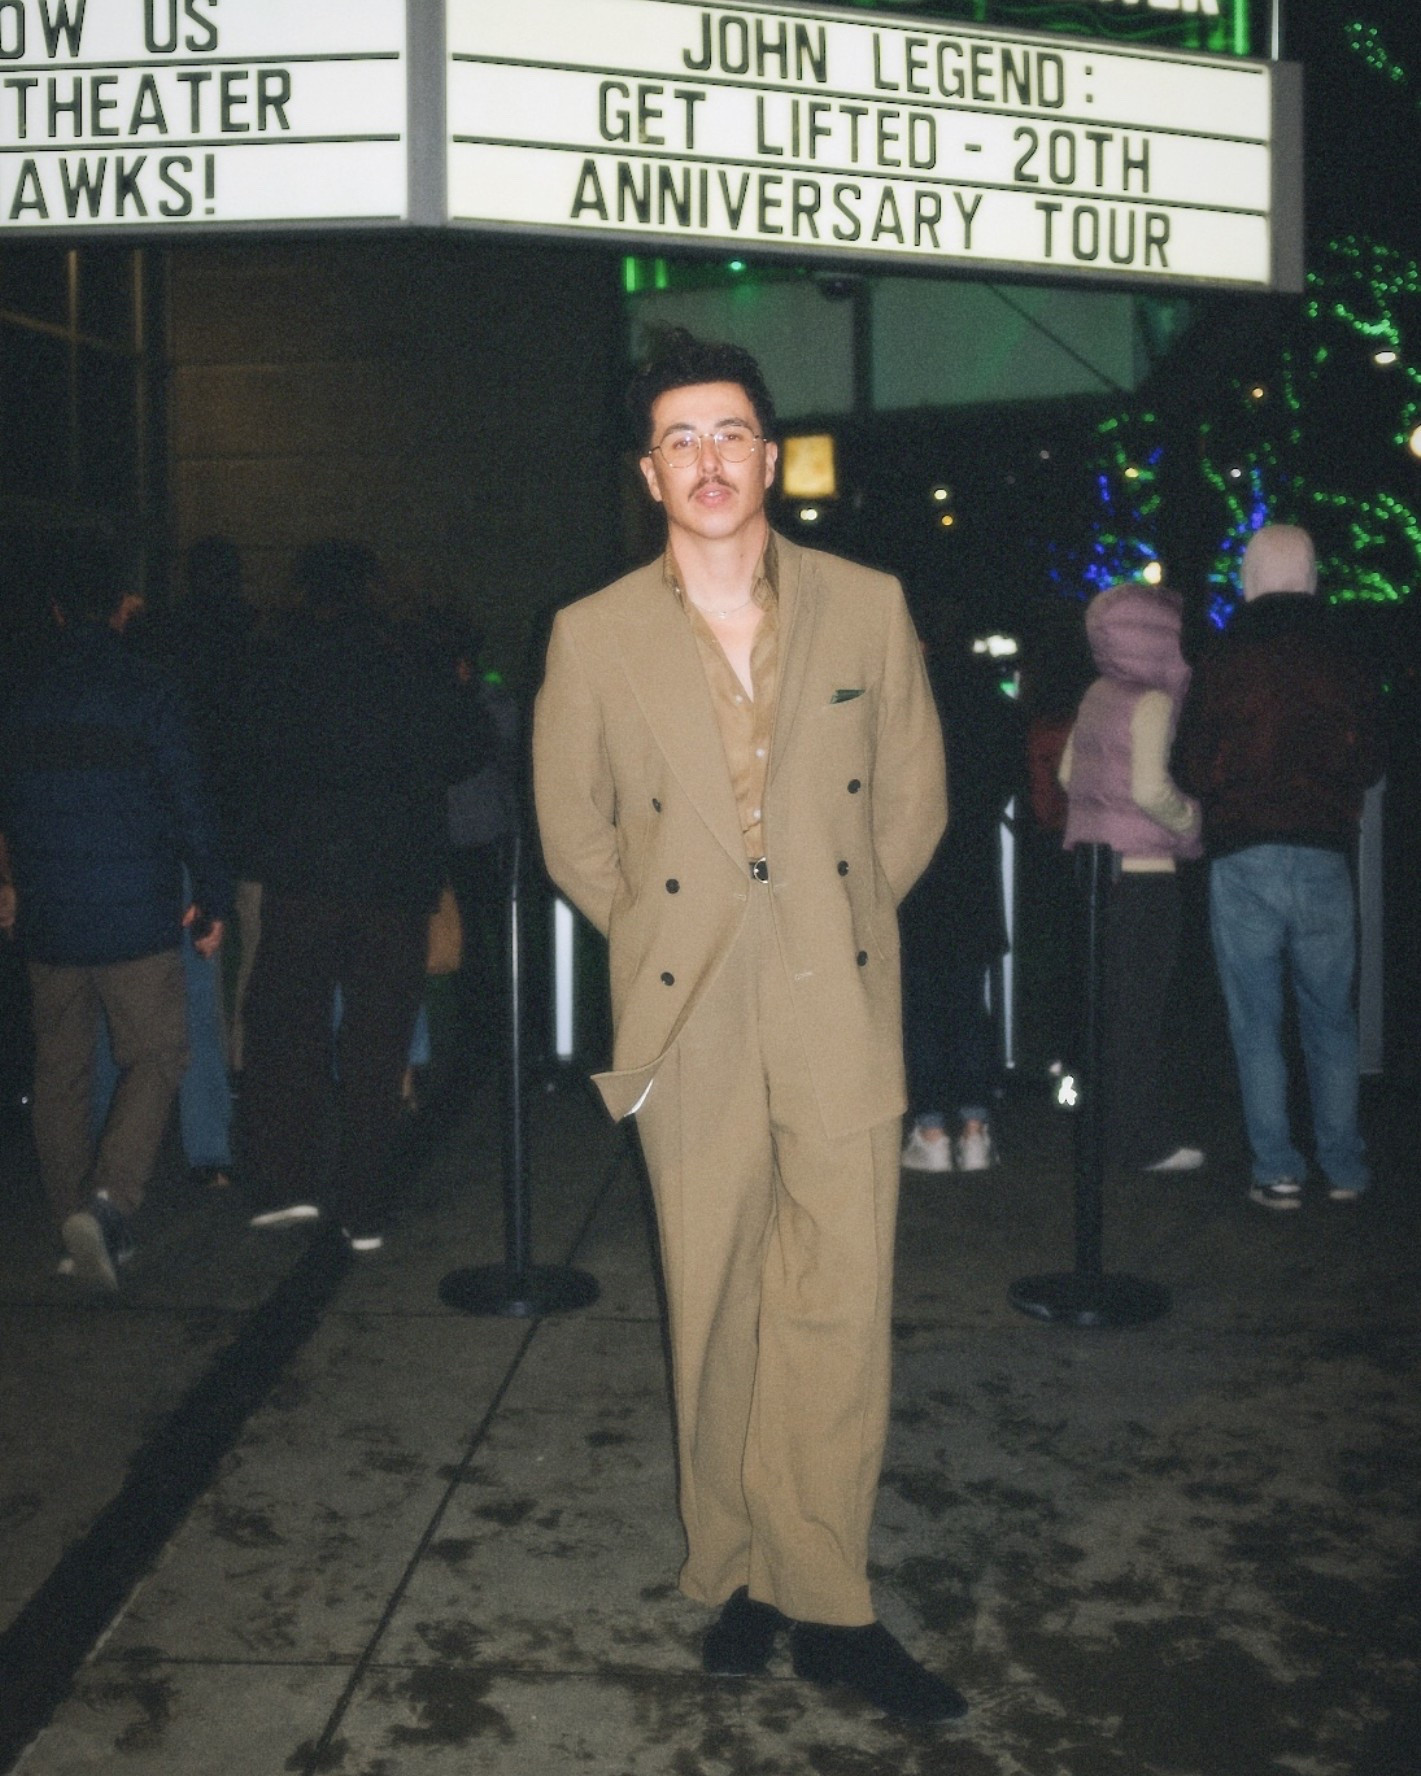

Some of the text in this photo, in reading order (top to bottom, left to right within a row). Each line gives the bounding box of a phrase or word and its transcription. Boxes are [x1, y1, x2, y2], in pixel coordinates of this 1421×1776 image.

[144, 0, 218, 53] US
[683, 13, 827, 83] JOHN
[4, 69, 291, 139] THEATER
[599, 81, 1149, 193] GET LIFTED - 20TH
[570, 159, 1171, 267] ANNIVERSARY TOUR
